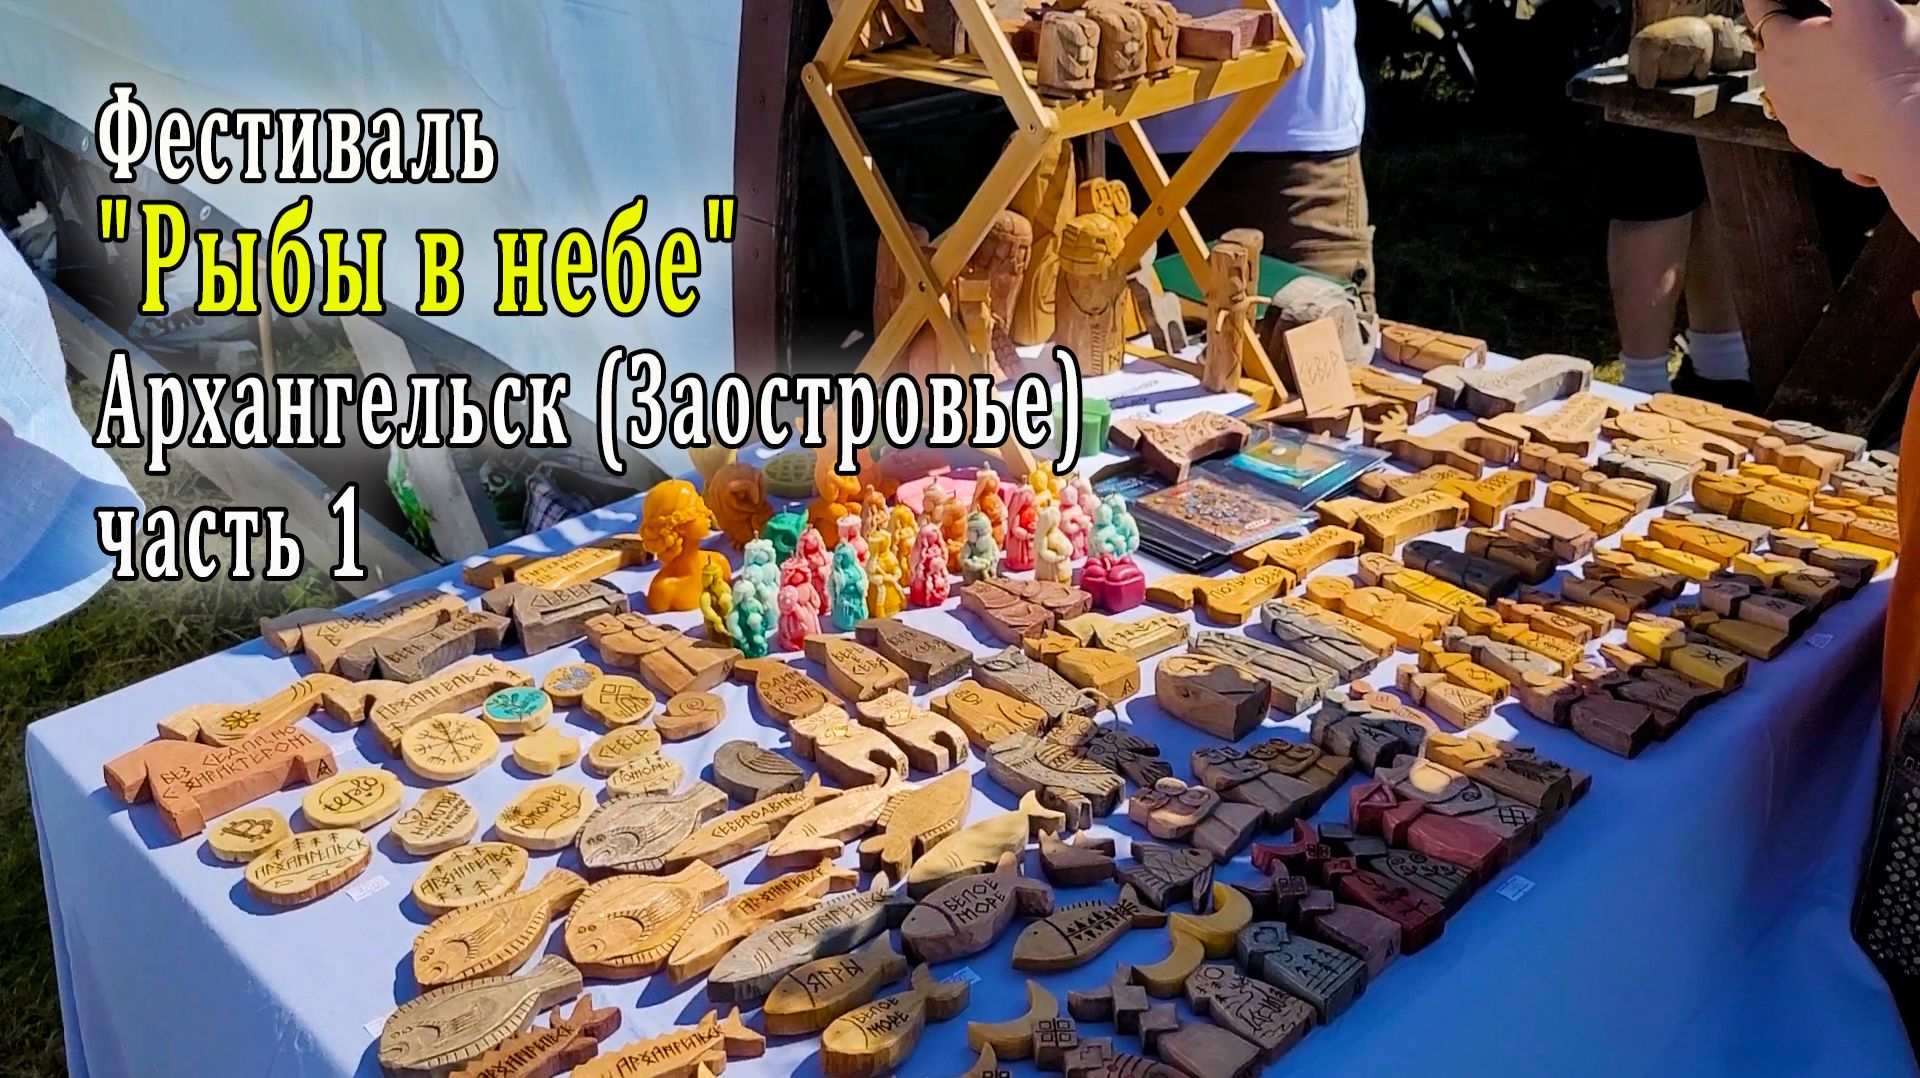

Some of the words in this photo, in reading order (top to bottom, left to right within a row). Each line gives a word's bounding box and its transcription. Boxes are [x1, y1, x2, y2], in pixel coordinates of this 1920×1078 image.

[530, 583, 593, 607] СЕВЕР
[599, 728, 650, 758] СЕВЕР
[160, 766, 191, 785] БЕЗ
[943, 878, 999, 912] БЕЛОЕ
[955, 891, 1006, 925] МОРЕ
[806, 958, 863, 994] ЯГРЫ
[851, 996, 899, 1024] БЕЛОЕ
[866, 1011, 909, 1038] МОРЕ
